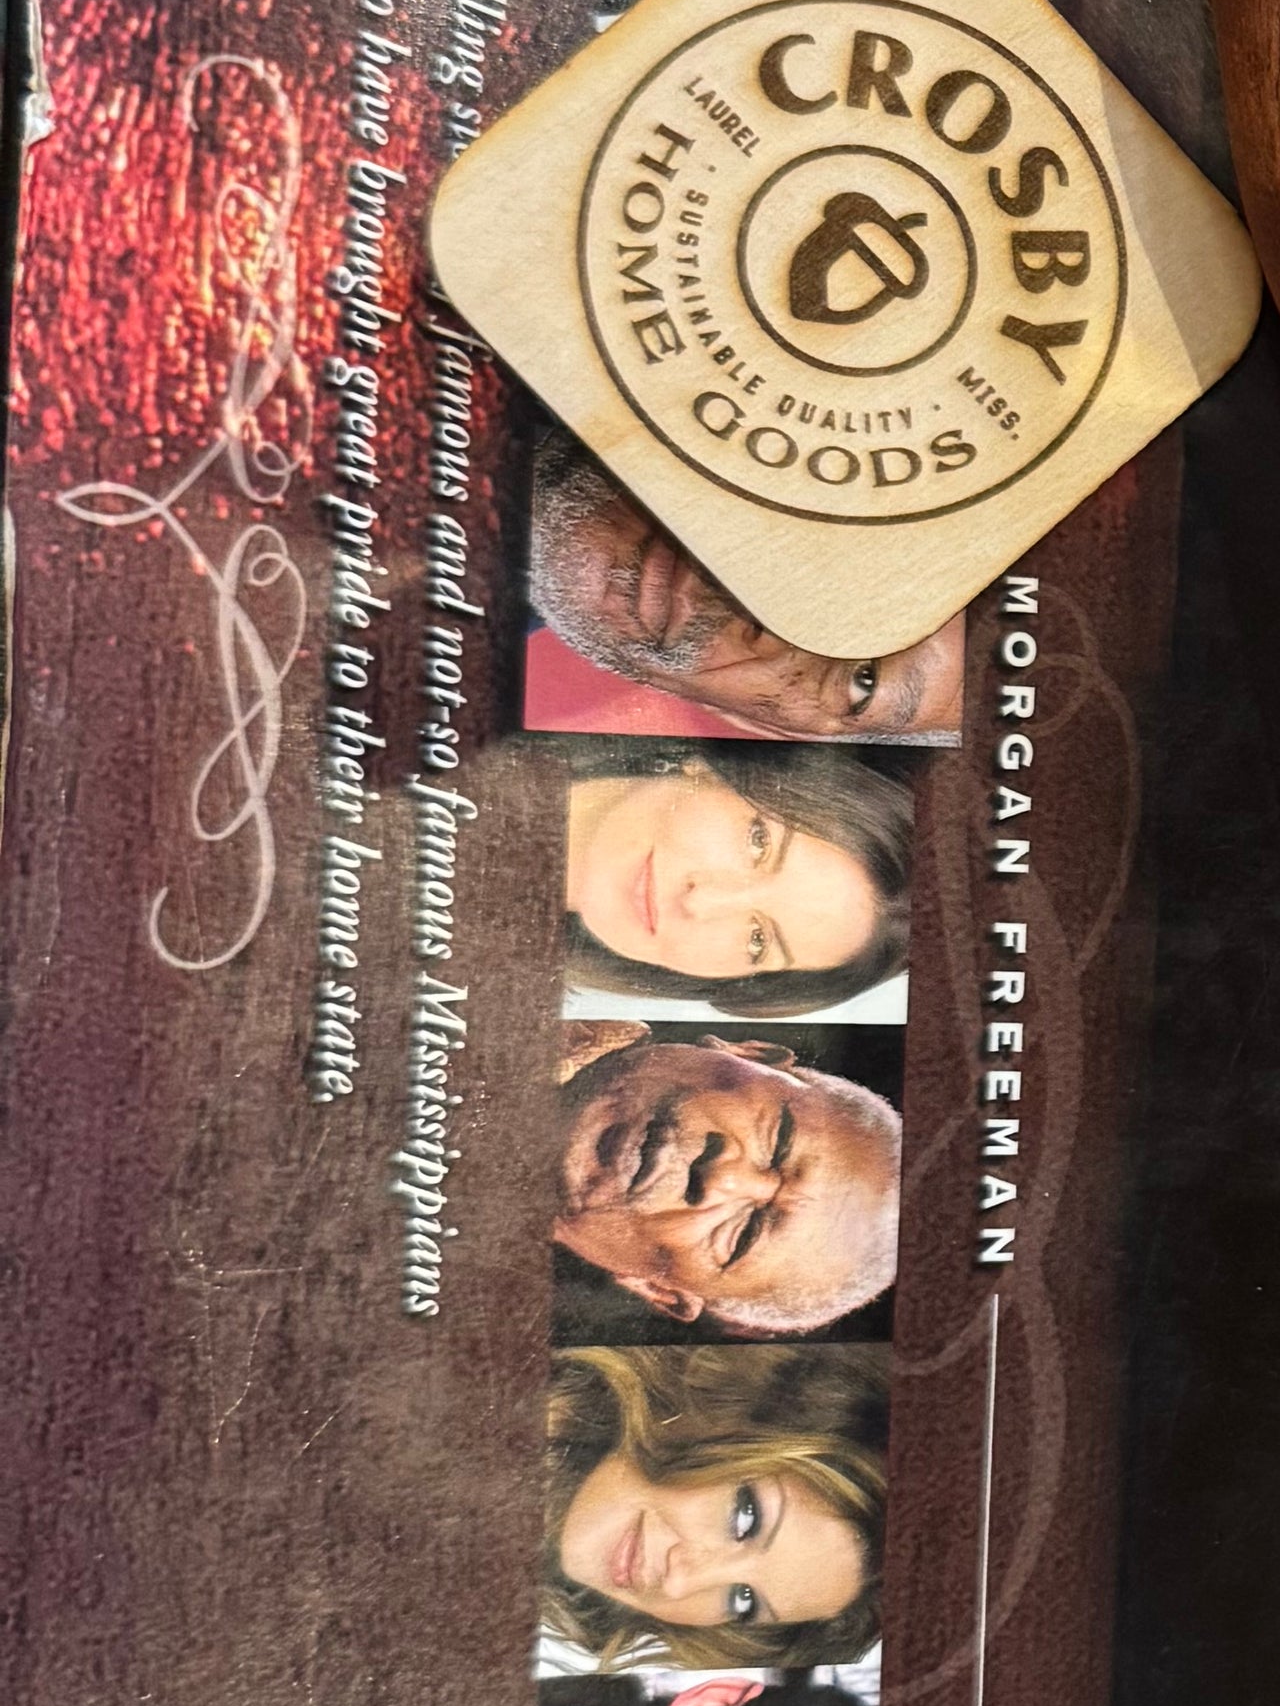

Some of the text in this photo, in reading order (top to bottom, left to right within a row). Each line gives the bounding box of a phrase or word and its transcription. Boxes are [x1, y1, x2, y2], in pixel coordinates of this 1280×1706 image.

[358, 29, 410, 146] have
[683, 76, 761, 159] LAUREL
[330, 159, 407, 353] brought
[759, 29, 1091, 386] CROSBY
[616, 123, 977, 489] HOME GOODS
[677, 187, 915, 435] SUSTAINABLE QUALITY
[325, 357, 380, 488] great
[956, 365, 1022, 442] MISS.
[323, 494, 391, 629] pride
[333, 644, 374, 690] to
[328, 706, 387, 824] their
[394, 314, 493, 1317] famous and not-so famous Mississippians
[326, 836, 382, 969] home
[978, 574, 1039, 1263] MORGAN FREEMAN
[312, 980, 361, 1103] state.
